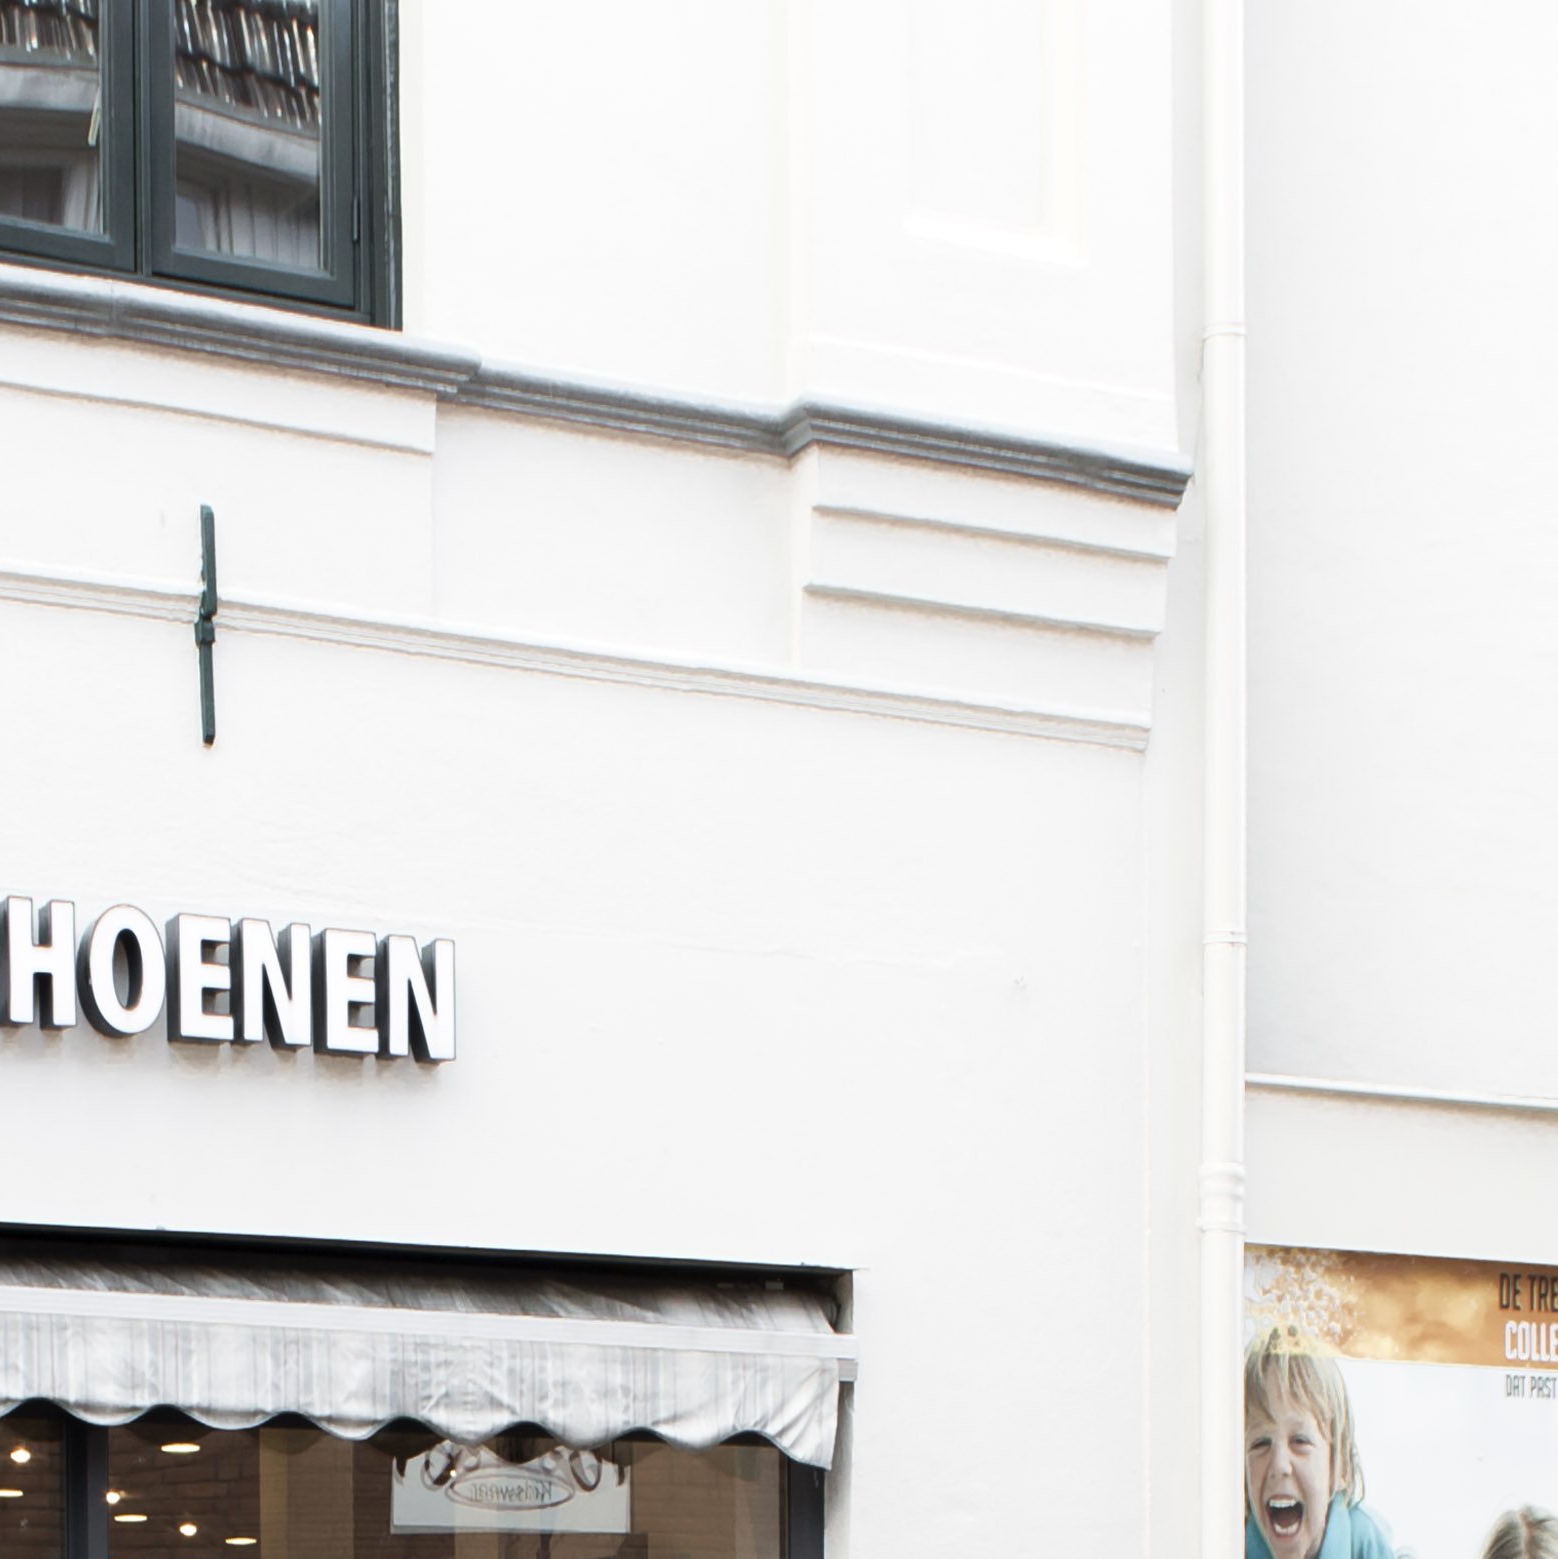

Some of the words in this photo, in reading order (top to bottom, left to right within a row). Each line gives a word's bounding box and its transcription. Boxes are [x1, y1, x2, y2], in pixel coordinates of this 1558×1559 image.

[1499, 1272, 1522, 1311] DE
[1505, 1374, 1526, 1398] DAT
[1529, 1376, 1557, 1399] PAST
